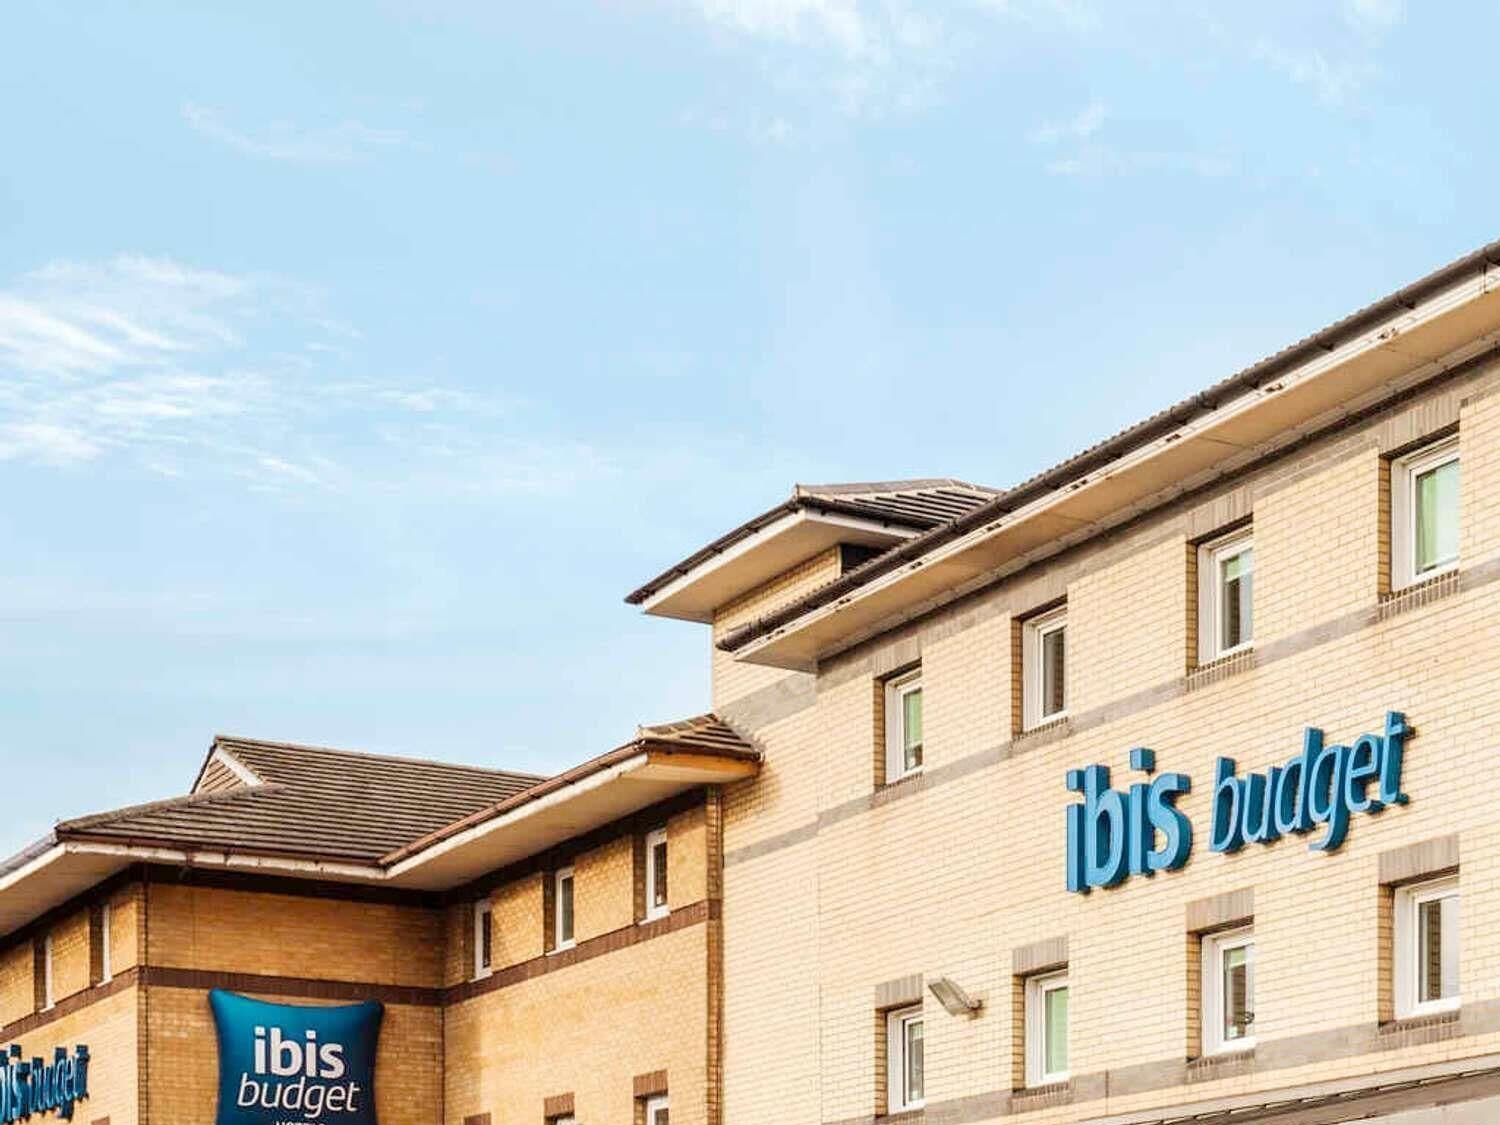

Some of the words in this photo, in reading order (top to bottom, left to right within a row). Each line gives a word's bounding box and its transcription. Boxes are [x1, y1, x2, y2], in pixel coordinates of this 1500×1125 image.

[1065, 746, 1194, 894] ibis
[1209, 710, 1414, 855] budget
[254, 1026, 346, 1080] ibis
[236, 1071, 361, 1119] budget
